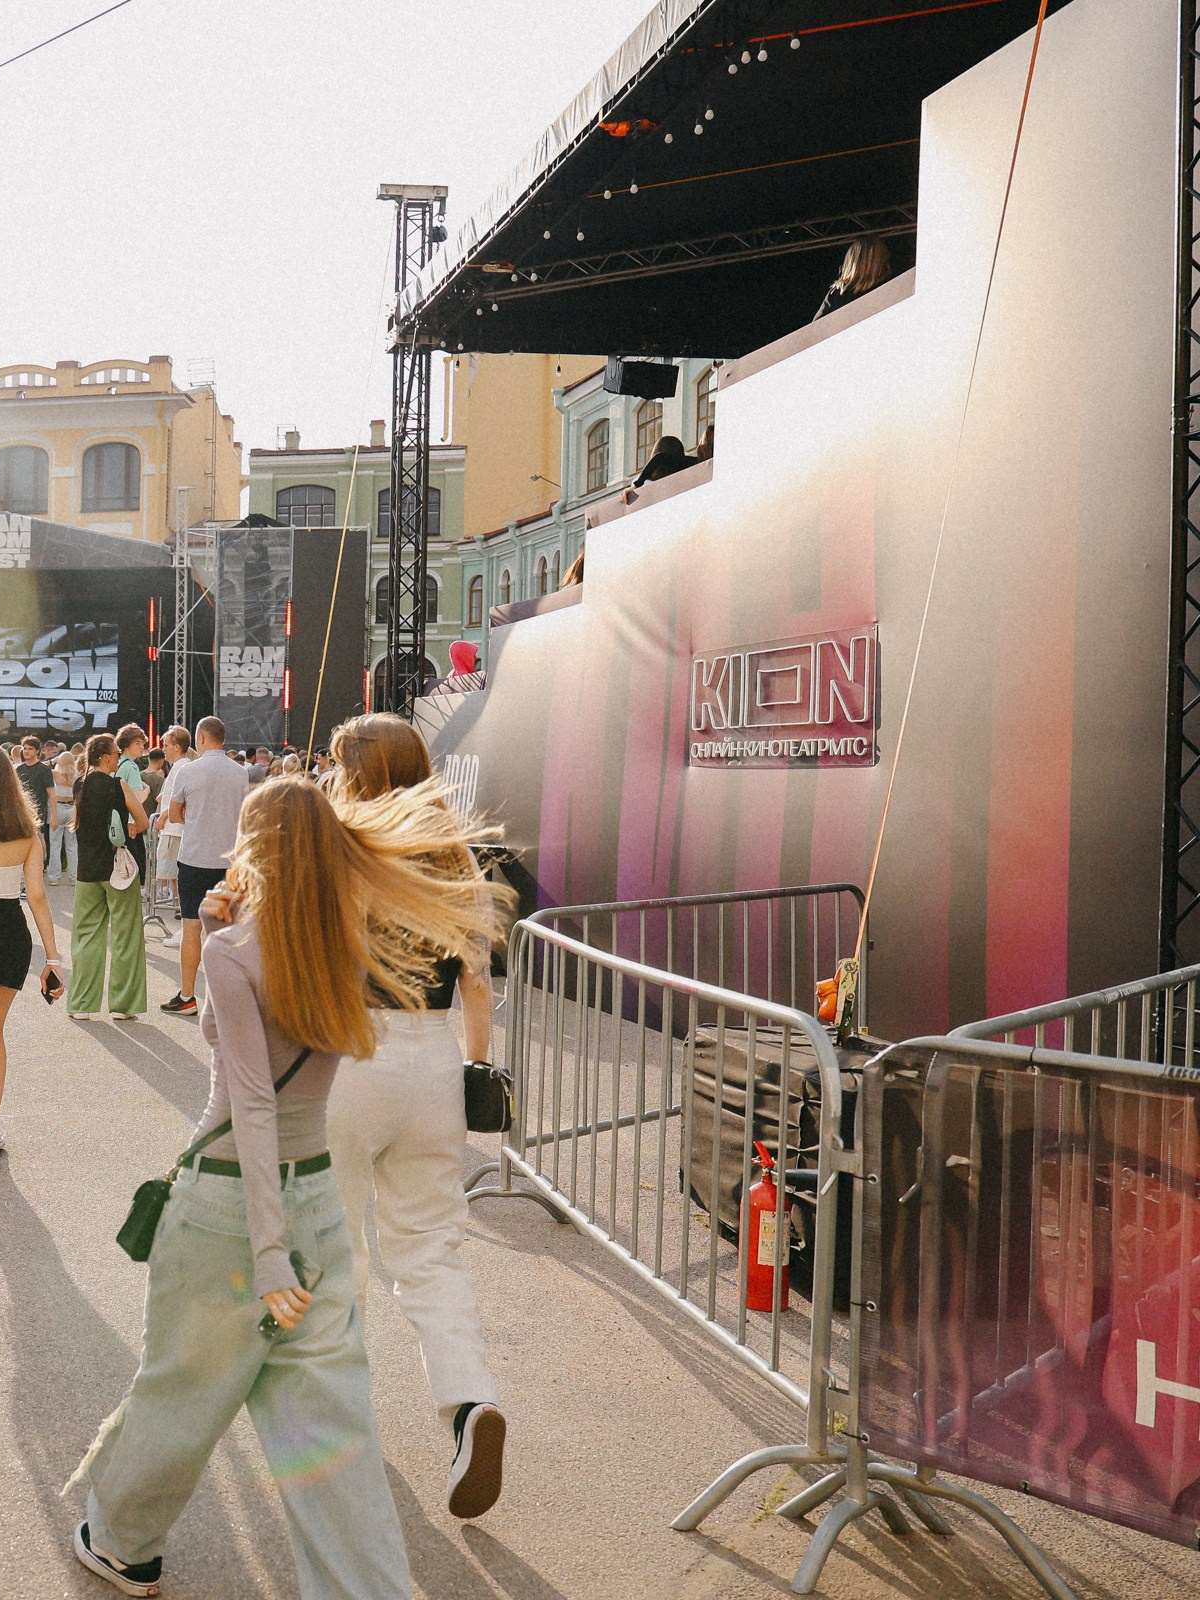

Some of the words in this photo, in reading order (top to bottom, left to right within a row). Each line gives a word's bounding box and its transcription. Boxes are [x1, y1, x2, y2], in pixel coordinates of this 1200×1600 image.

[220, 646, 286, 662] RAN
[220, 662, 285, 677] DOM
[220, 682, 284, 697] FEST
[692, 635, 870, 730] KION
[98, 690, 118, 701] 2024
